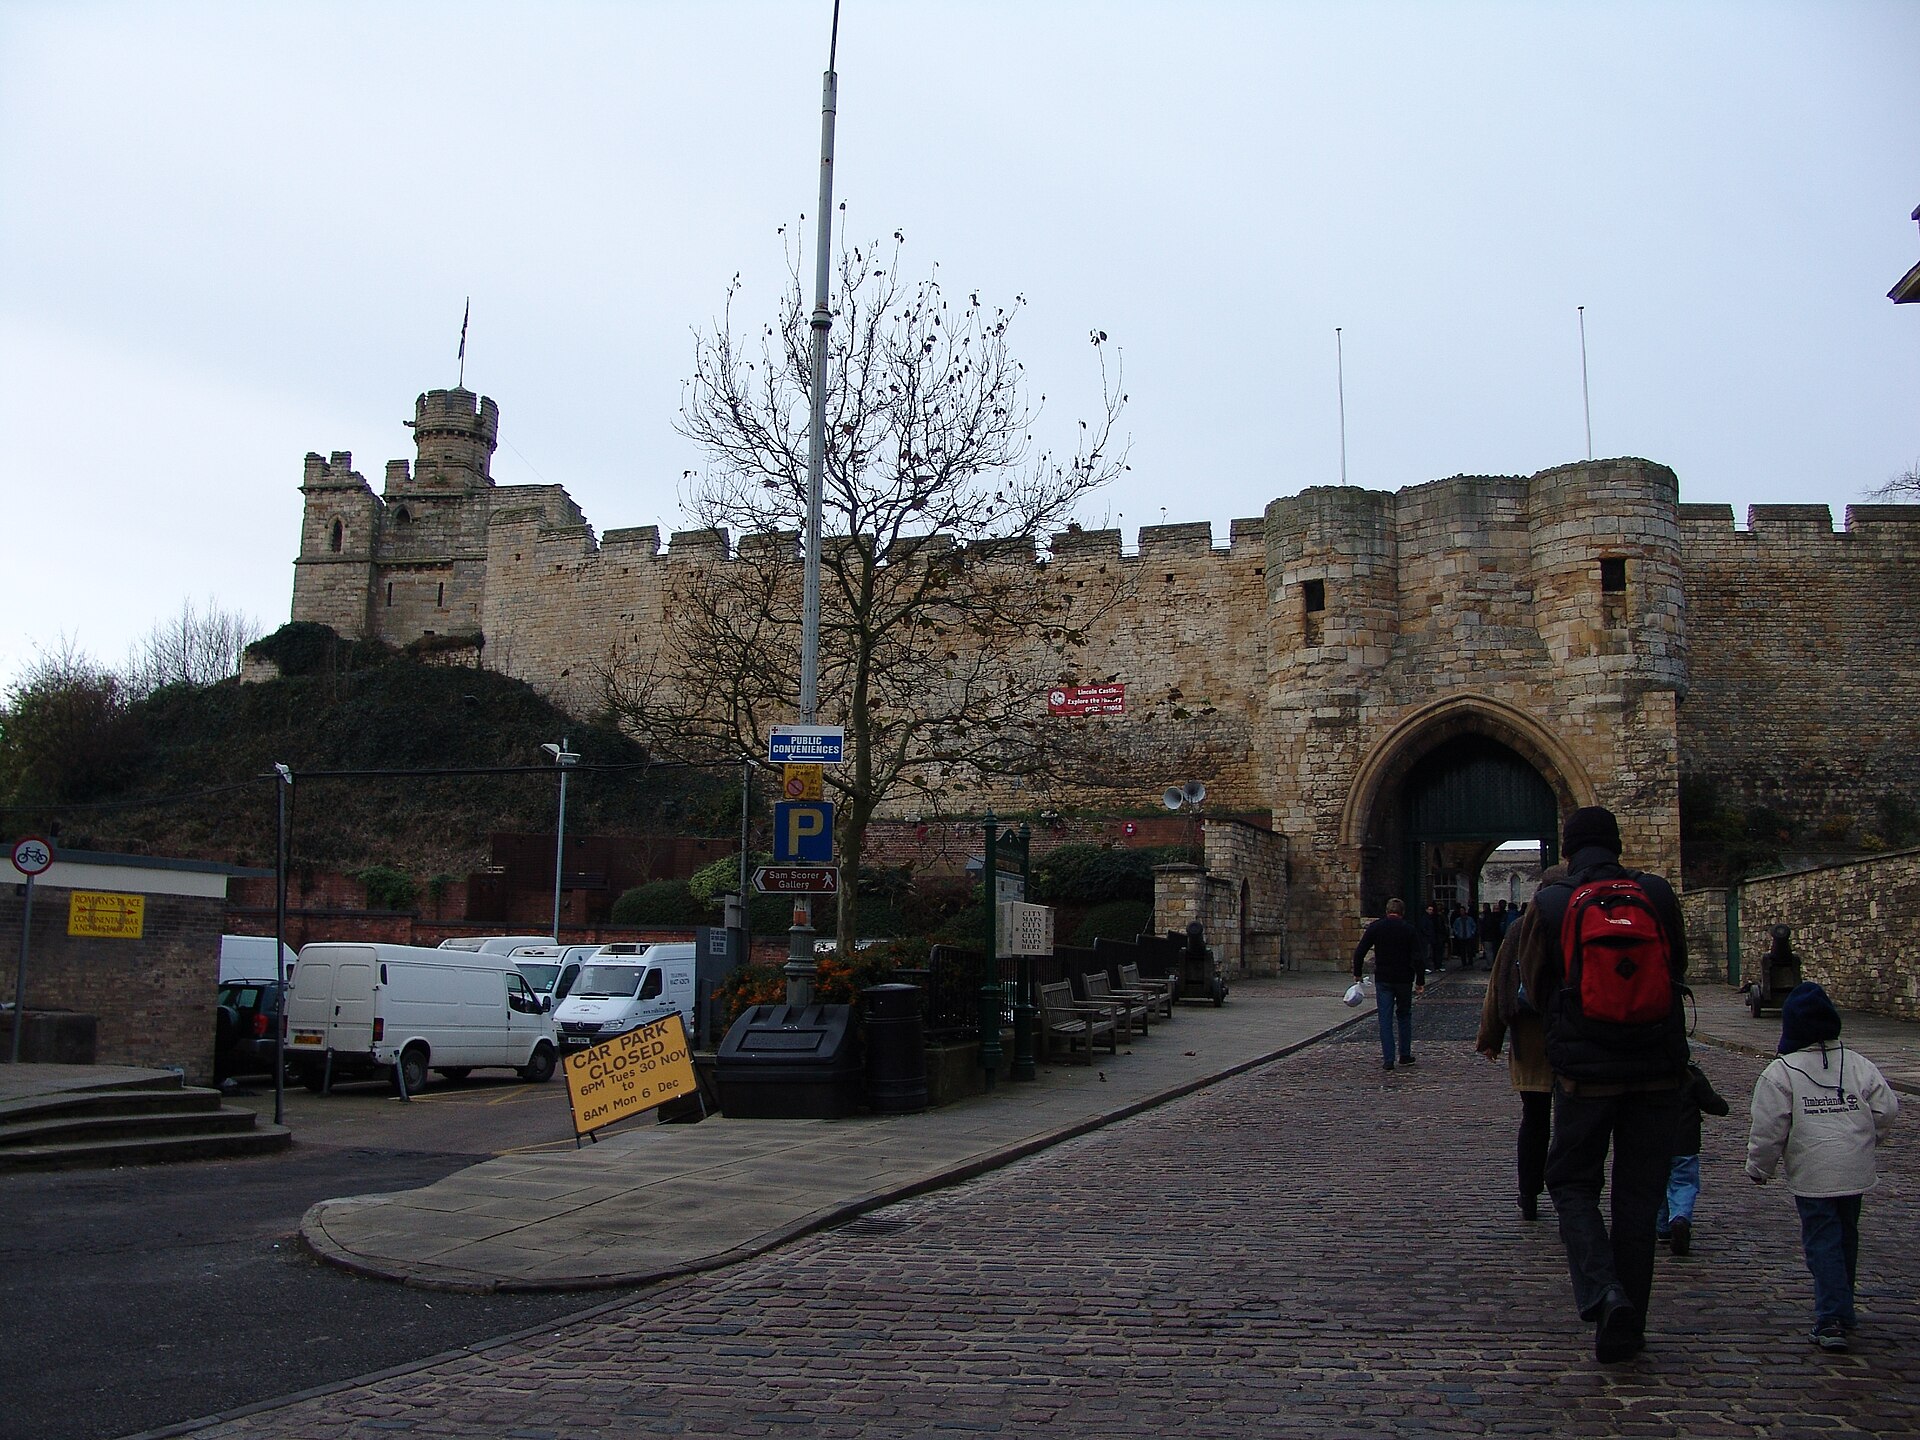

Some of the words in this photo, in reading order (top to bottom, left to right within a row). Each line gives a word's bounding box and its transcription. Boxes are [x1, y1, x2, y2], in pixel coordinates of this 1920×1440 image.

[1077, 688, 1097, 696] Lincoln
[1067, 698, 1089, 706] Explore
[790, 736, 822, 745] PUBLIC
[772, 744, 840, 754] CONVENIENCES
[788, 808, 824, 856] P
[769, 871, 788, 879] Sam
[791, 871, 819, 879] Scorer
[778, 880, 810, 890] Gallery
[75, 895, 115, 905] ROMAN'S
[117, 898, 141, 907] PLACE
[74, 915, 122, 925] CONTINENTAL
[573, 1045, 611, 1069] CAR
[620, 1021, 669, 1051] PARK
[589, 1041, 665, 1080] CLOSED
[581, 1080, 605, 1096] 6PM
[609, 1069, 636, 1084] Tues
[640, 1060, 656, 1074] 30
[661, 1048, 687, 1066] NOV
[622, 1081, 635, 1092] to
[583, 1104, 609, 1121] 8AM
[613, 1095, 637, 1110] Mon
[642, 1088, 651, 1098] 6
[658, 1079, 680, 1093] Dec
